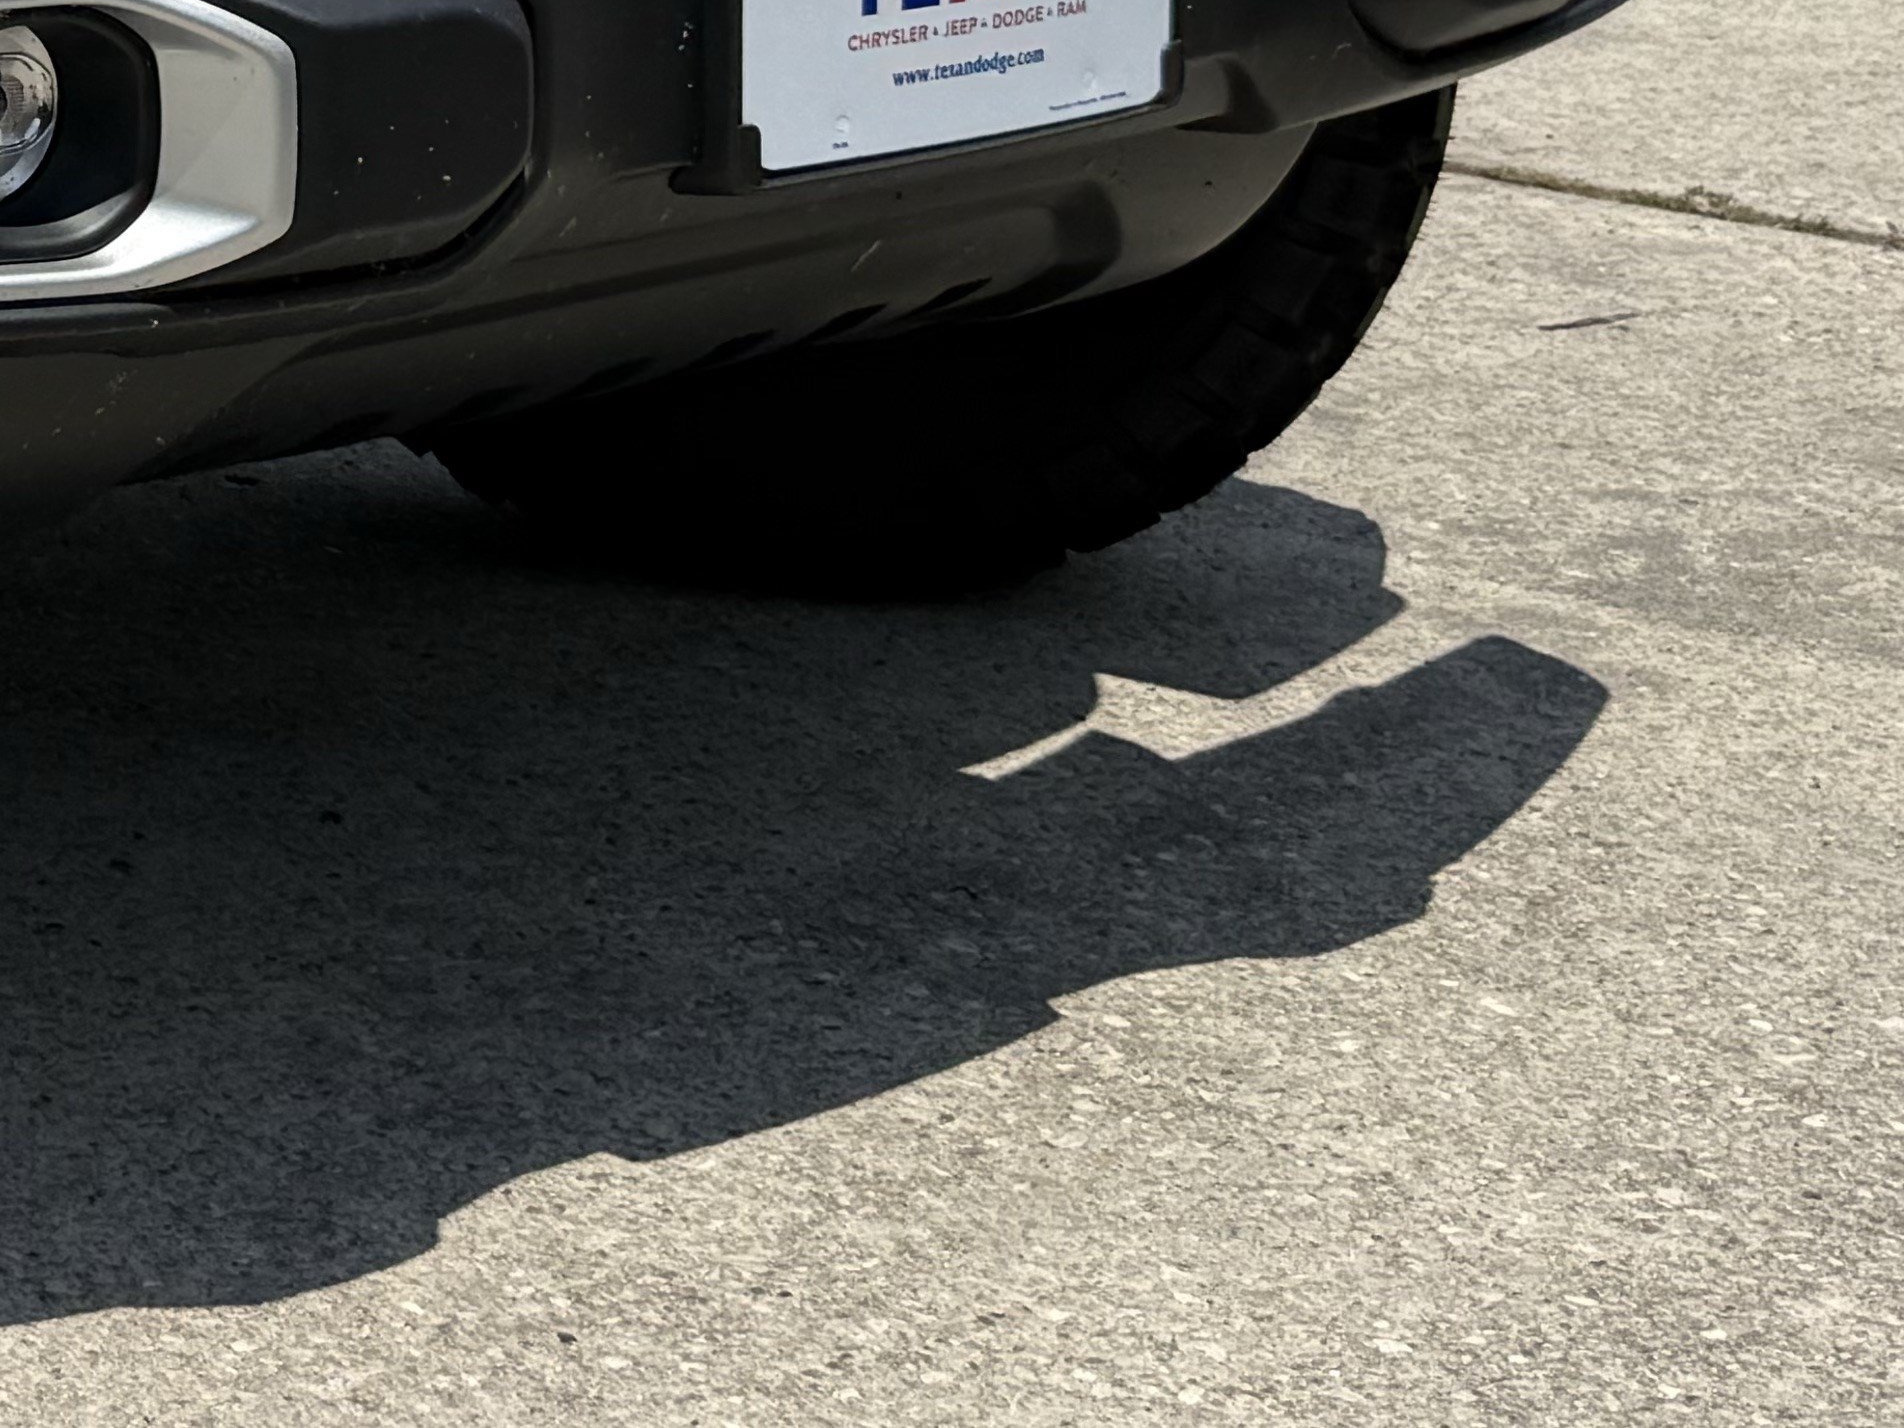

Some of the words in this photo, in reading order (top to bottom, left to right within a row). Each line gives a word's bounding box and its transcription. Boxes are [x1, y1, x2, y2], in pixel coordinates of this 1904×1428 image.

[847, 25, 929, 52] CHRYSLER
[944, 17, 978, 38] JEEP
[992, 5, 1044, 29] DODGE
[892, 48, 1045, 87] www.texandodge.com
